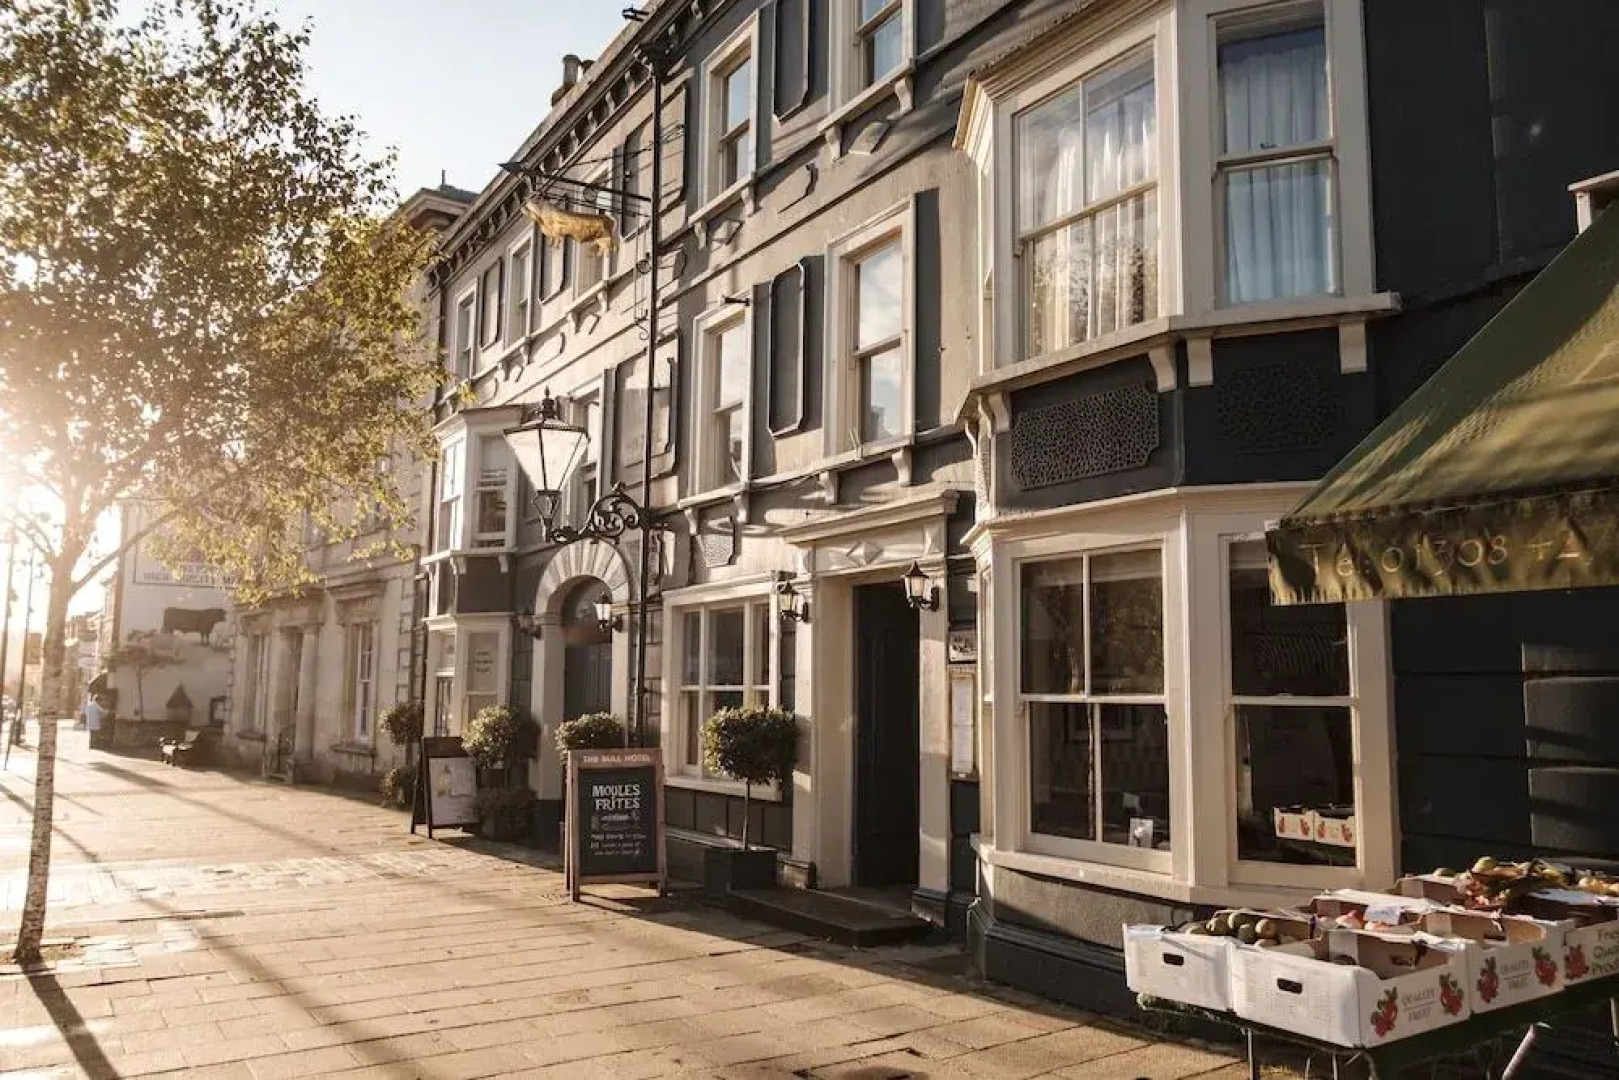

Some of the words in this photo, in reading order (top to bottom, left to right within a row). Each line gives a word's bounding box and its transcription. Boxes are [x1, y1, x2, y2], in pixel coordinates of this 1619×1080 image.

[583, 755, 599, 763] THE
[624, 754, 650, 762] HOTEL
[592, 784, 640, 798] MOULES
[595, 796, 640, 811] FRITES
